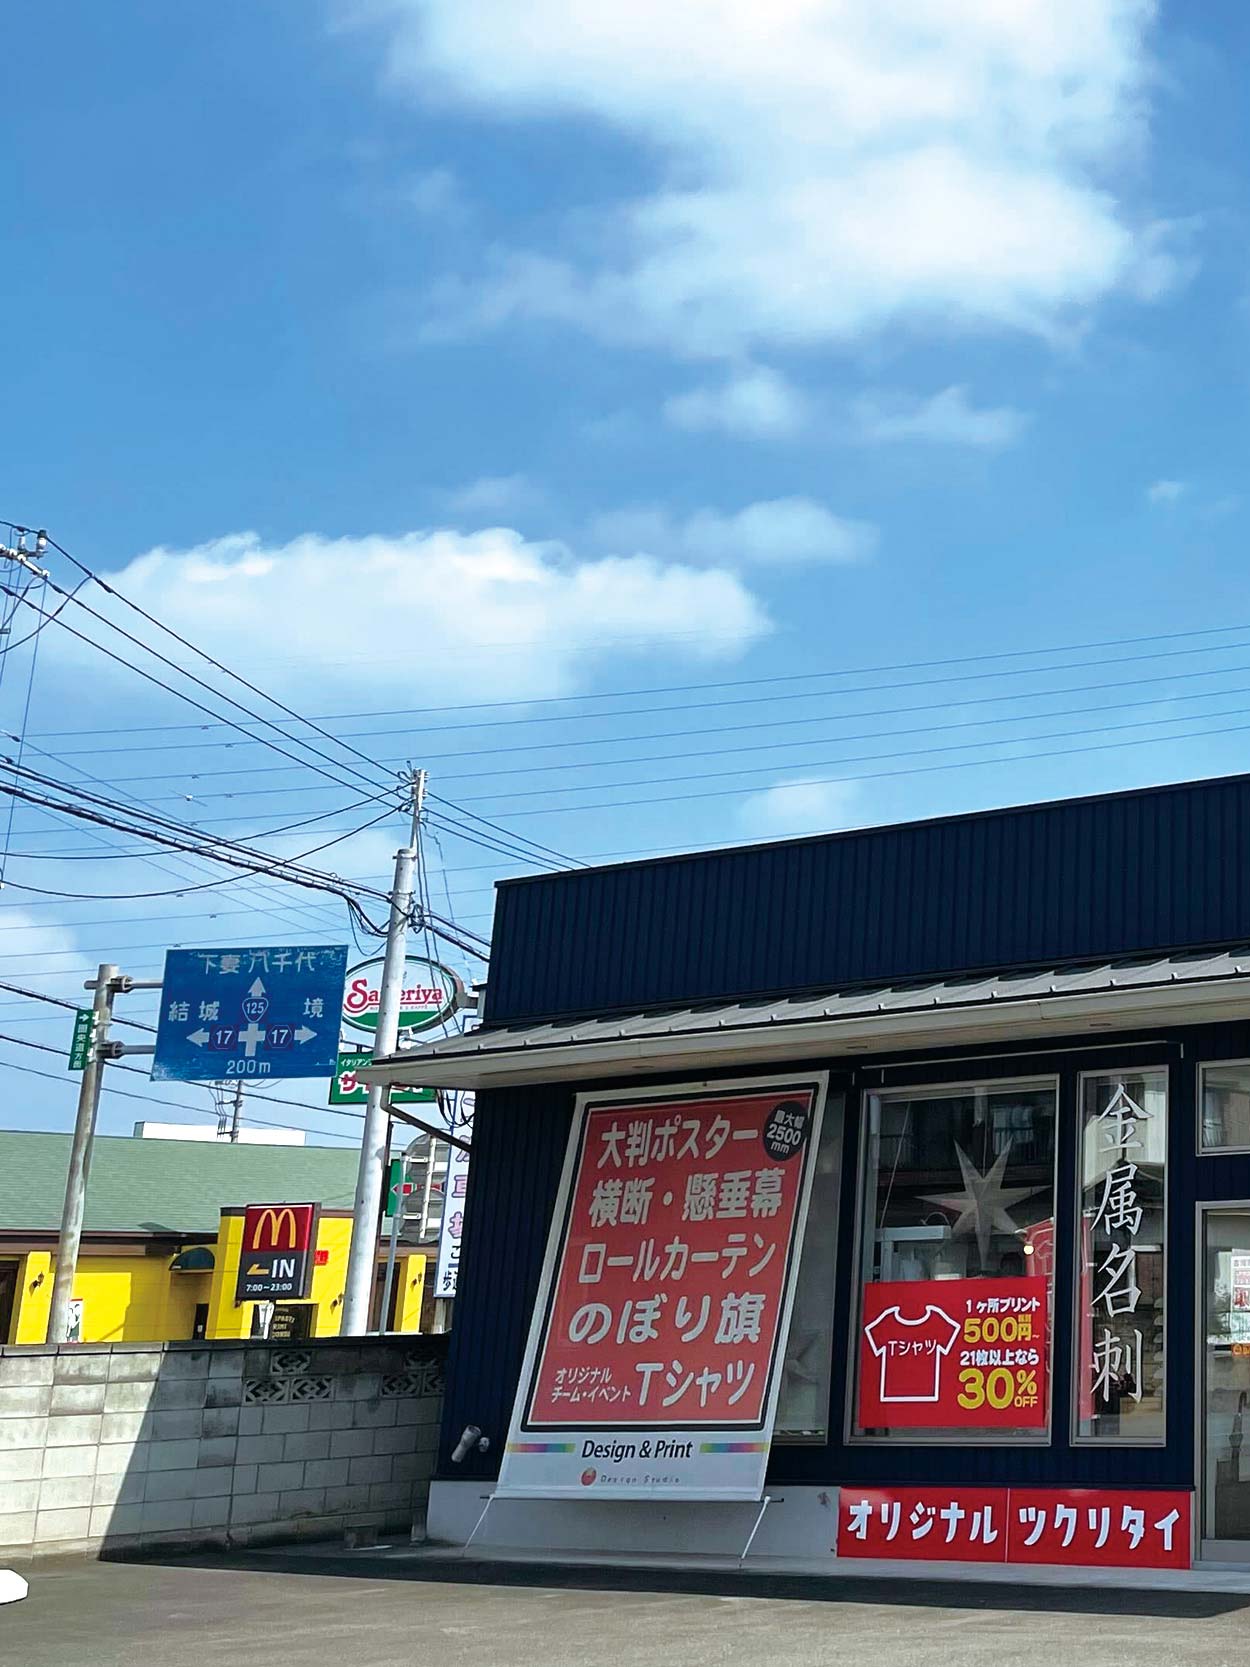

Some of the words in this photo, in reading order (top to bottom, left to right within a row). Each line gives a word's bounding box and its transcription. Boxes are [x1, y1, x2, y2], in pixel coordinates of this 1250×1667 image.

[199, 954, 241, 974] 下妻
[248, 951, 316, 973] 八千代
[346, 978, 442, 1009] Saeriya
[168, 1000, 220, 1022] 結城
[246, 1002, 264, 1015] 125
[303, 998, 324, 1018] 境
[215, 1030, 233, 1045] 17
[271, 1029, 289, 1044] 17
[226, 1059, 271, 1075] 200m
[597, 1114, 759, 1168] 大判ポスター
[767, 1123, 801, 1145] 2500
[771, 1141, 790, 1153] mm
[588, 1167, 785, 1228] 横断・懸垂幕
[1090, 1084, 1153, 1403] 金属名刺
[272, 1259, 295, 1278] IN
[578, 1233, 776, 1283] ロールカーテン
[568, 1291, 766, 1346] のぼり旗
[888, 1339, 938, 1357] Tシャツ
[555, 1367, 612, 1384] オリジナル
[635, 1360, 755, 1407] Tシャツ
[551, 1386, 632, 1403] チーム・イベント
[957, 1368, 1037, 1409] 30%
[1014, 1396, 1038, 1408] OFF
[581, 1440, 635, 1463] Design
[639, 1440, 651, 1459] &
[654, 1440, 693, 1459] Print
[847, 1500, 998, 1544] オリジナル
[1018, 1503, 1181, 1550] ツクリタイ
